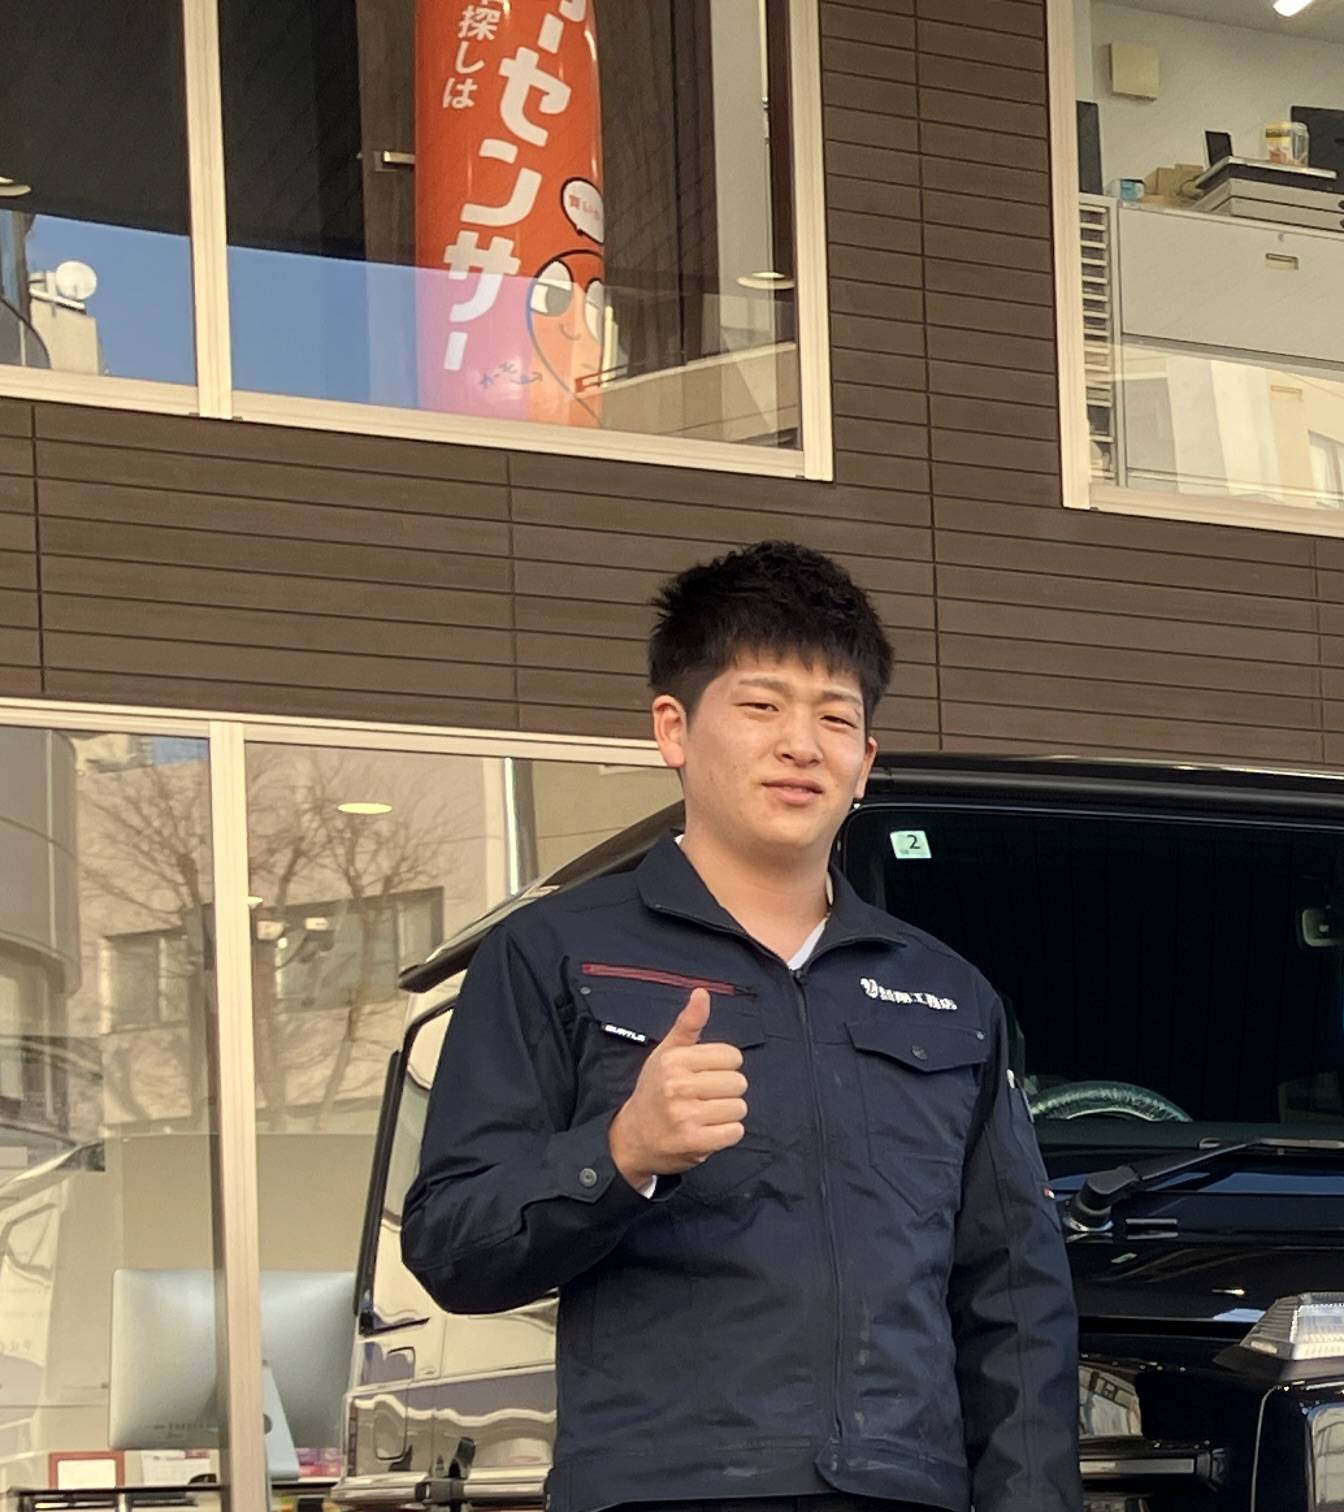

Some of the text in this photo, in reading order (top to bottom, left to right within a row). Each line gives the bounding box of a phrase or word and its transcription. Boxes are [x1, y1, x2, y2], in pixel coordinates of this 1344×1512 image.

[442, 0, 502, 109] 探しは
[442, 0, 590, 371] ーセンサー
[906, 834, 921, 850] 2
